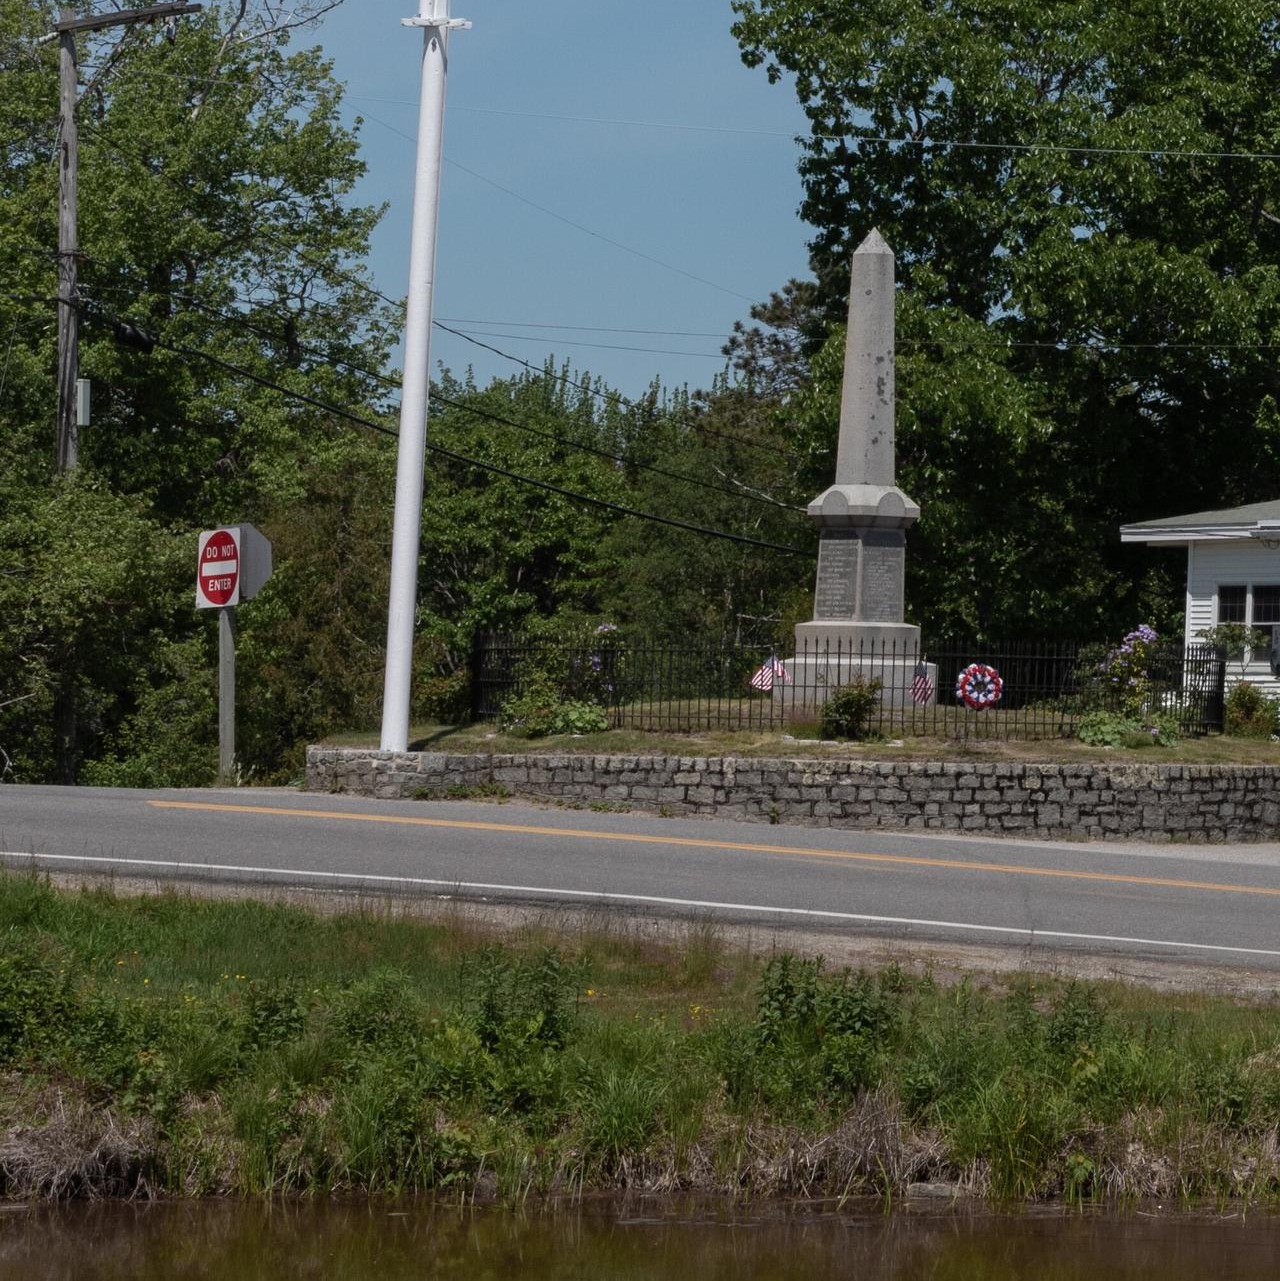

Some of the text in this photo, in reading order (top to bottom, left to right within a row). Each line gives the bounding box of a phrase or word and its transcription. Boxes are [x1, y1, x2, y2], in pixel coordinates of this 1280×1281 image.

[206, 545, 234, 558] DO NOT
[208, 579, 231, 591] ENTER
